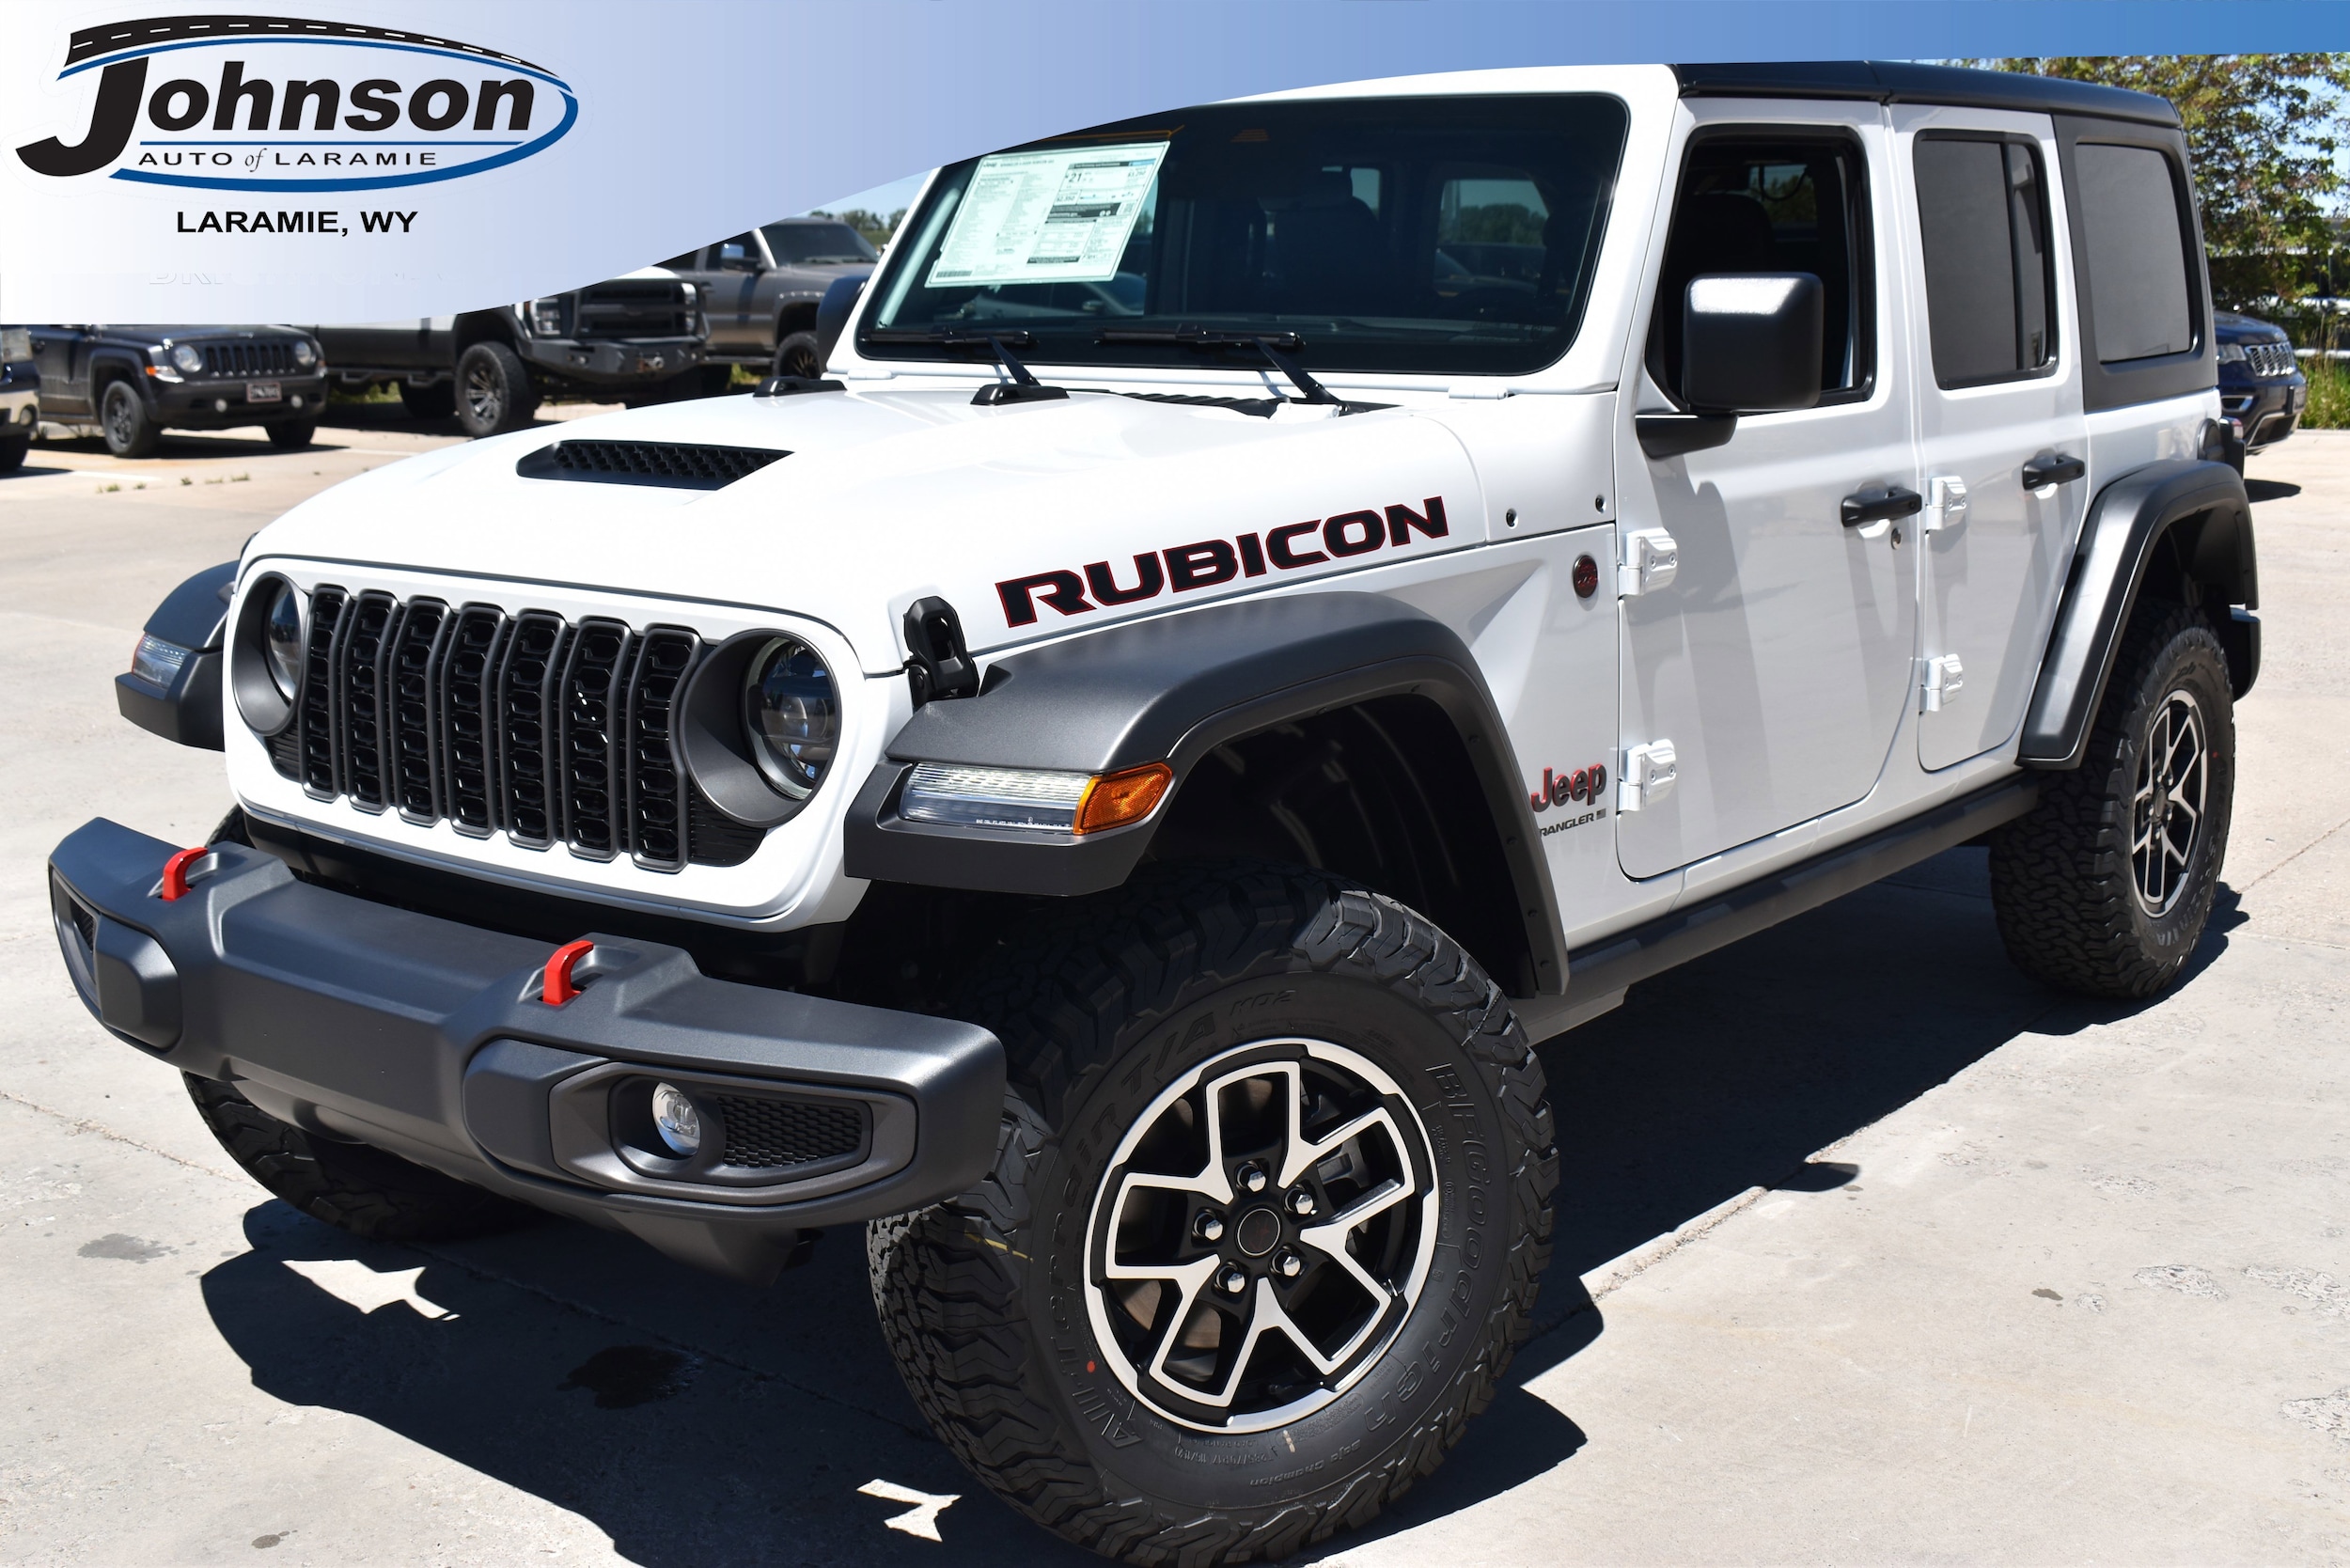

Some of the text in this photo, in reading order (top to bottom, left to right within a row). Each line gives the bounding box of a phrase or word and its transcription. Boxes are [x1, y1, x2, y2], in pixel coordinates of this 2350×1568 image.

[995, 495, 1449, 628] RUBICON
[1530, 762, 1607, 813] Jeep
[1539, 812, 1595, 837] RANGLER
[1121, 1011, 1216, 1097] T/A
[1249, 1438, 1361, 1487] Baja Champion
